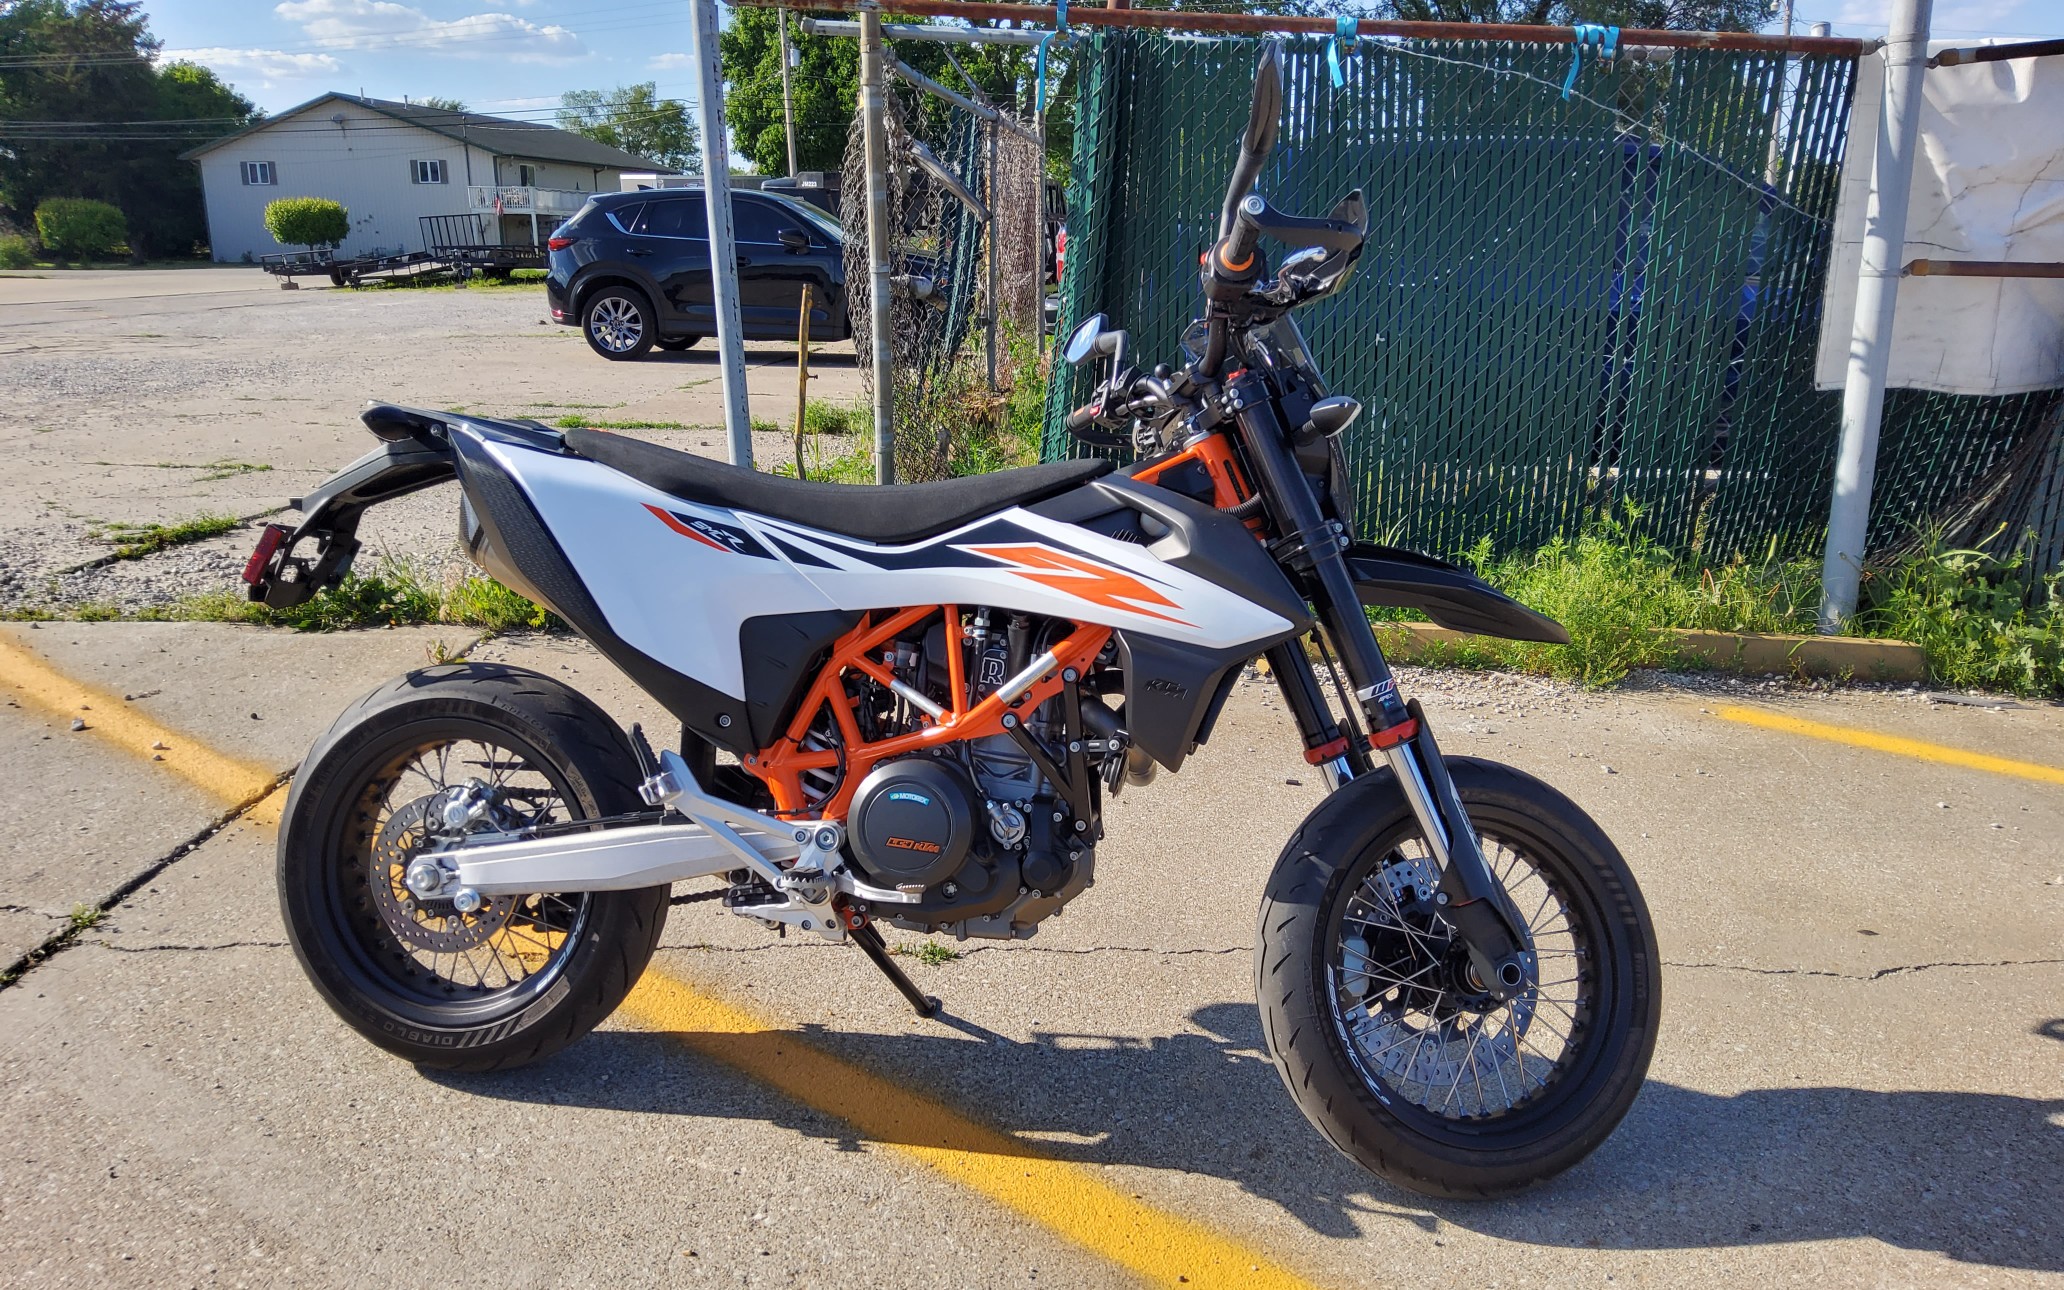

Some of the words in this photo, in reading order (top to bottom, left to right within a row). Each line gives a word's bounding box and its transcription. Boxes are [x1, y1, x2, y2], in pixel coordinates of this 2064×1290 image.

[980, 657, 1004, 685] R
[899, 792, 929, 805] MOTOREX
[913, 841, 940, 854] KTM
[384, 1021, 453, 1046] DIABLO
